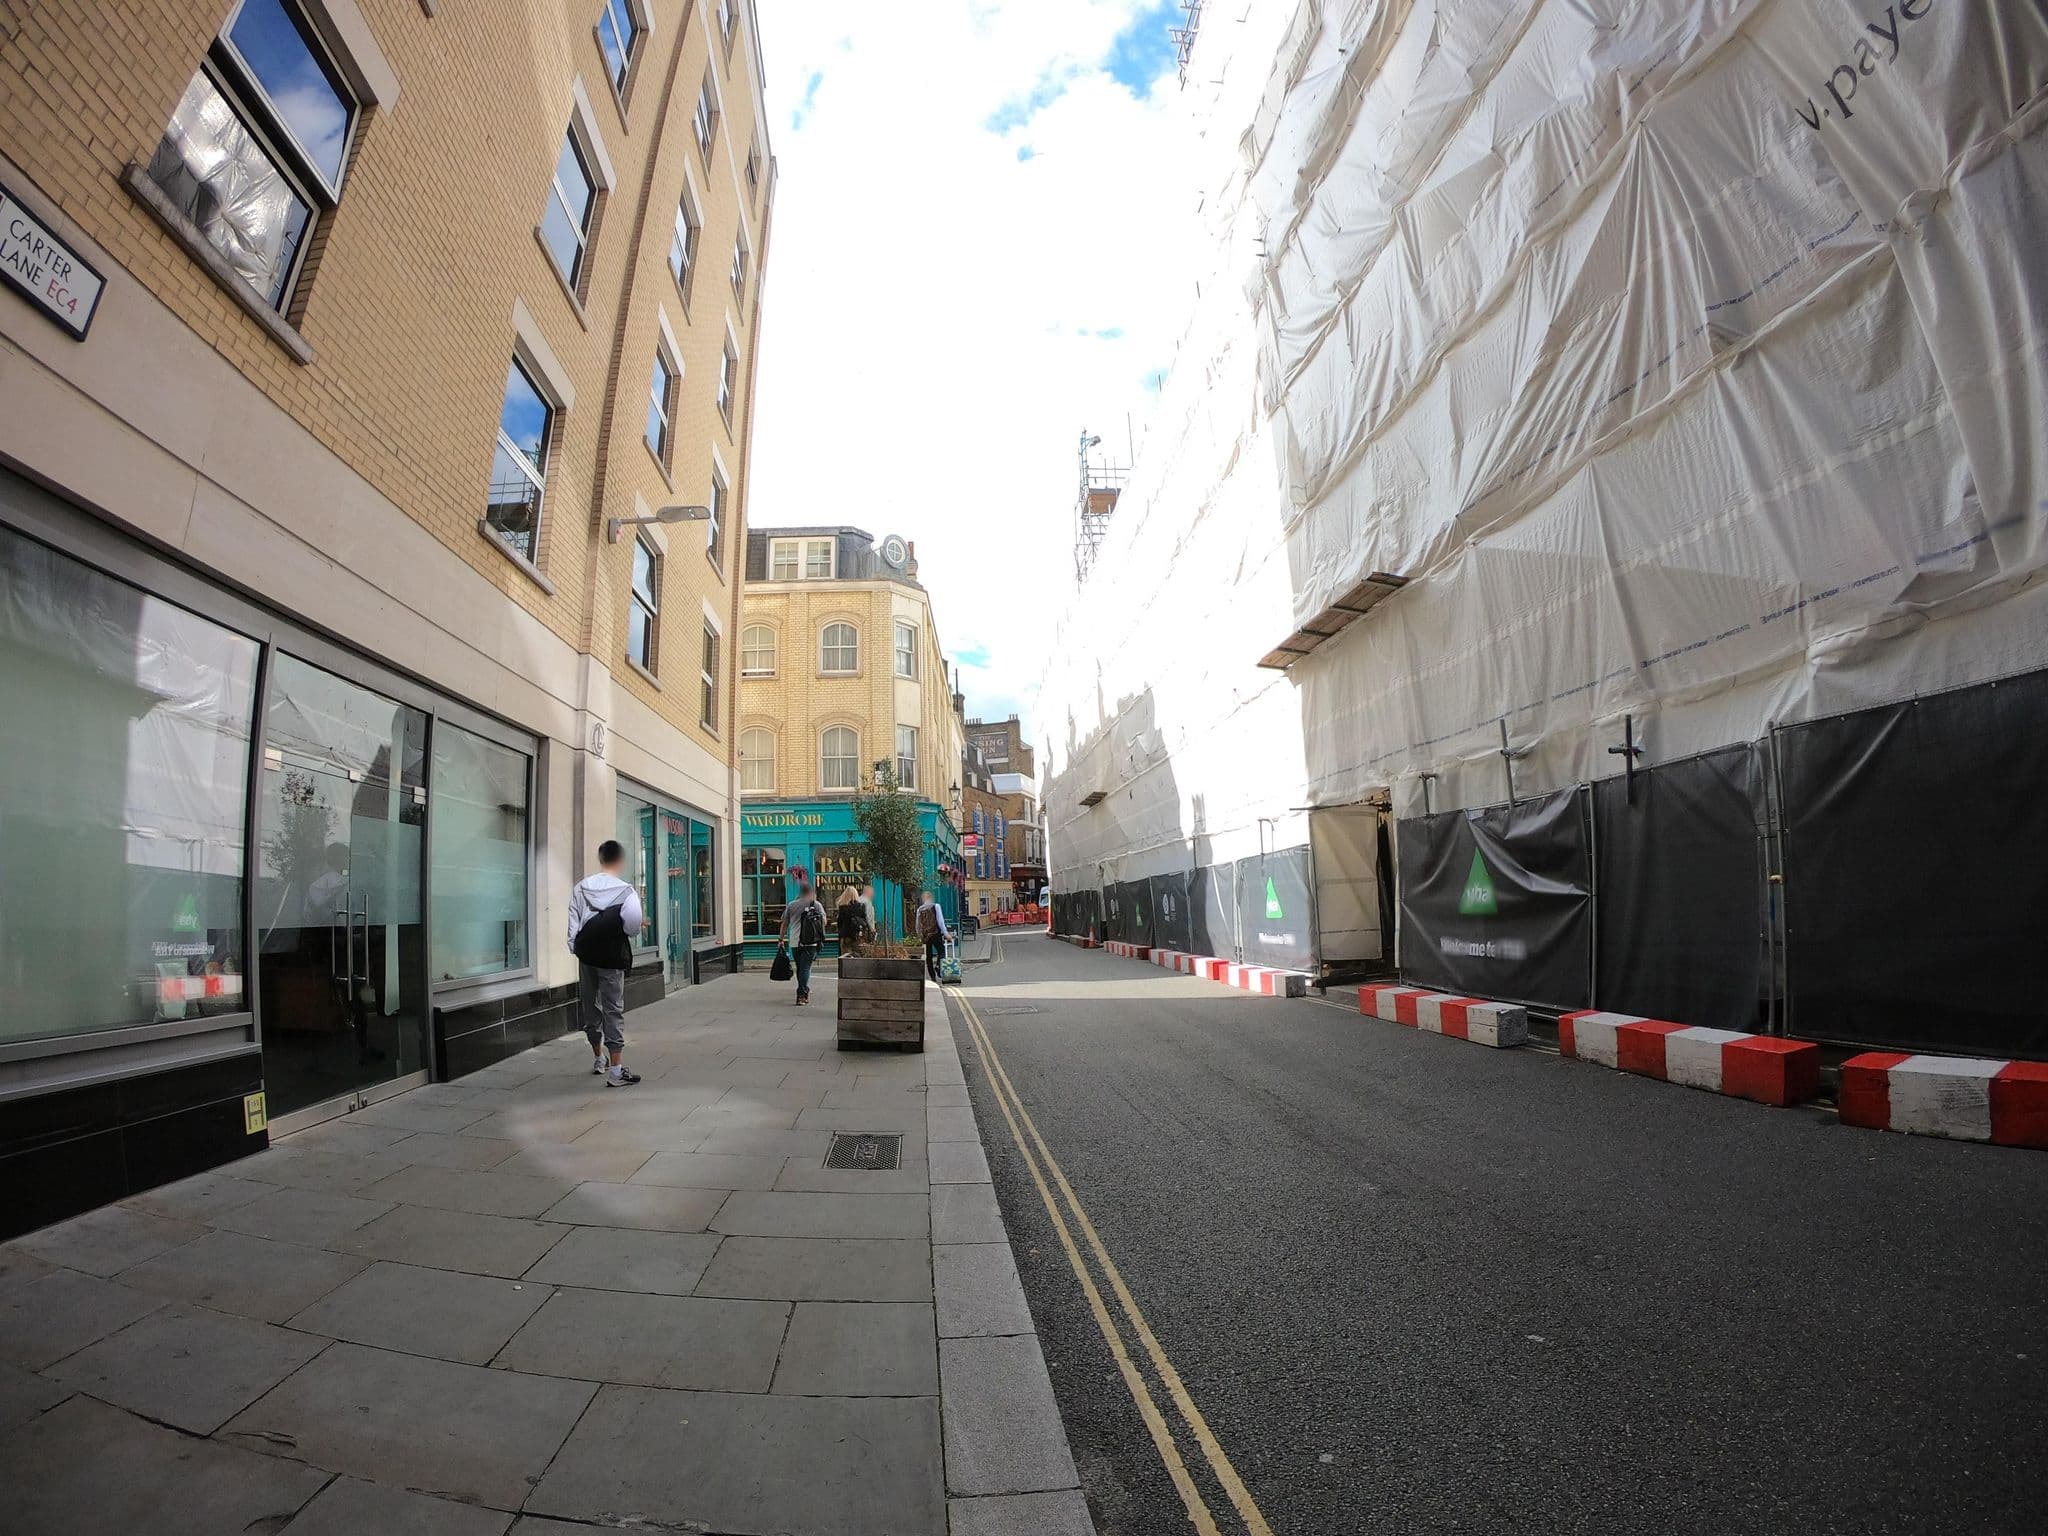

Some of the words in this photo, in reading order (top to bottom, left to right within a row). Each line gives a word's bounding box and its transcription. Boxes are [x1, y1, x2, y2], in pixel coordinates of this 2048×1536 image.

[10, 219, 72, 283] CARTER
[0, 239, 44, 287] LANE
[46, 279, 78, 315] EC4
[746, 814, 824, 827] WARDROBE
[820, 856, 862, 873] BAR
[820, 875, 864, 884] KITCHEN
